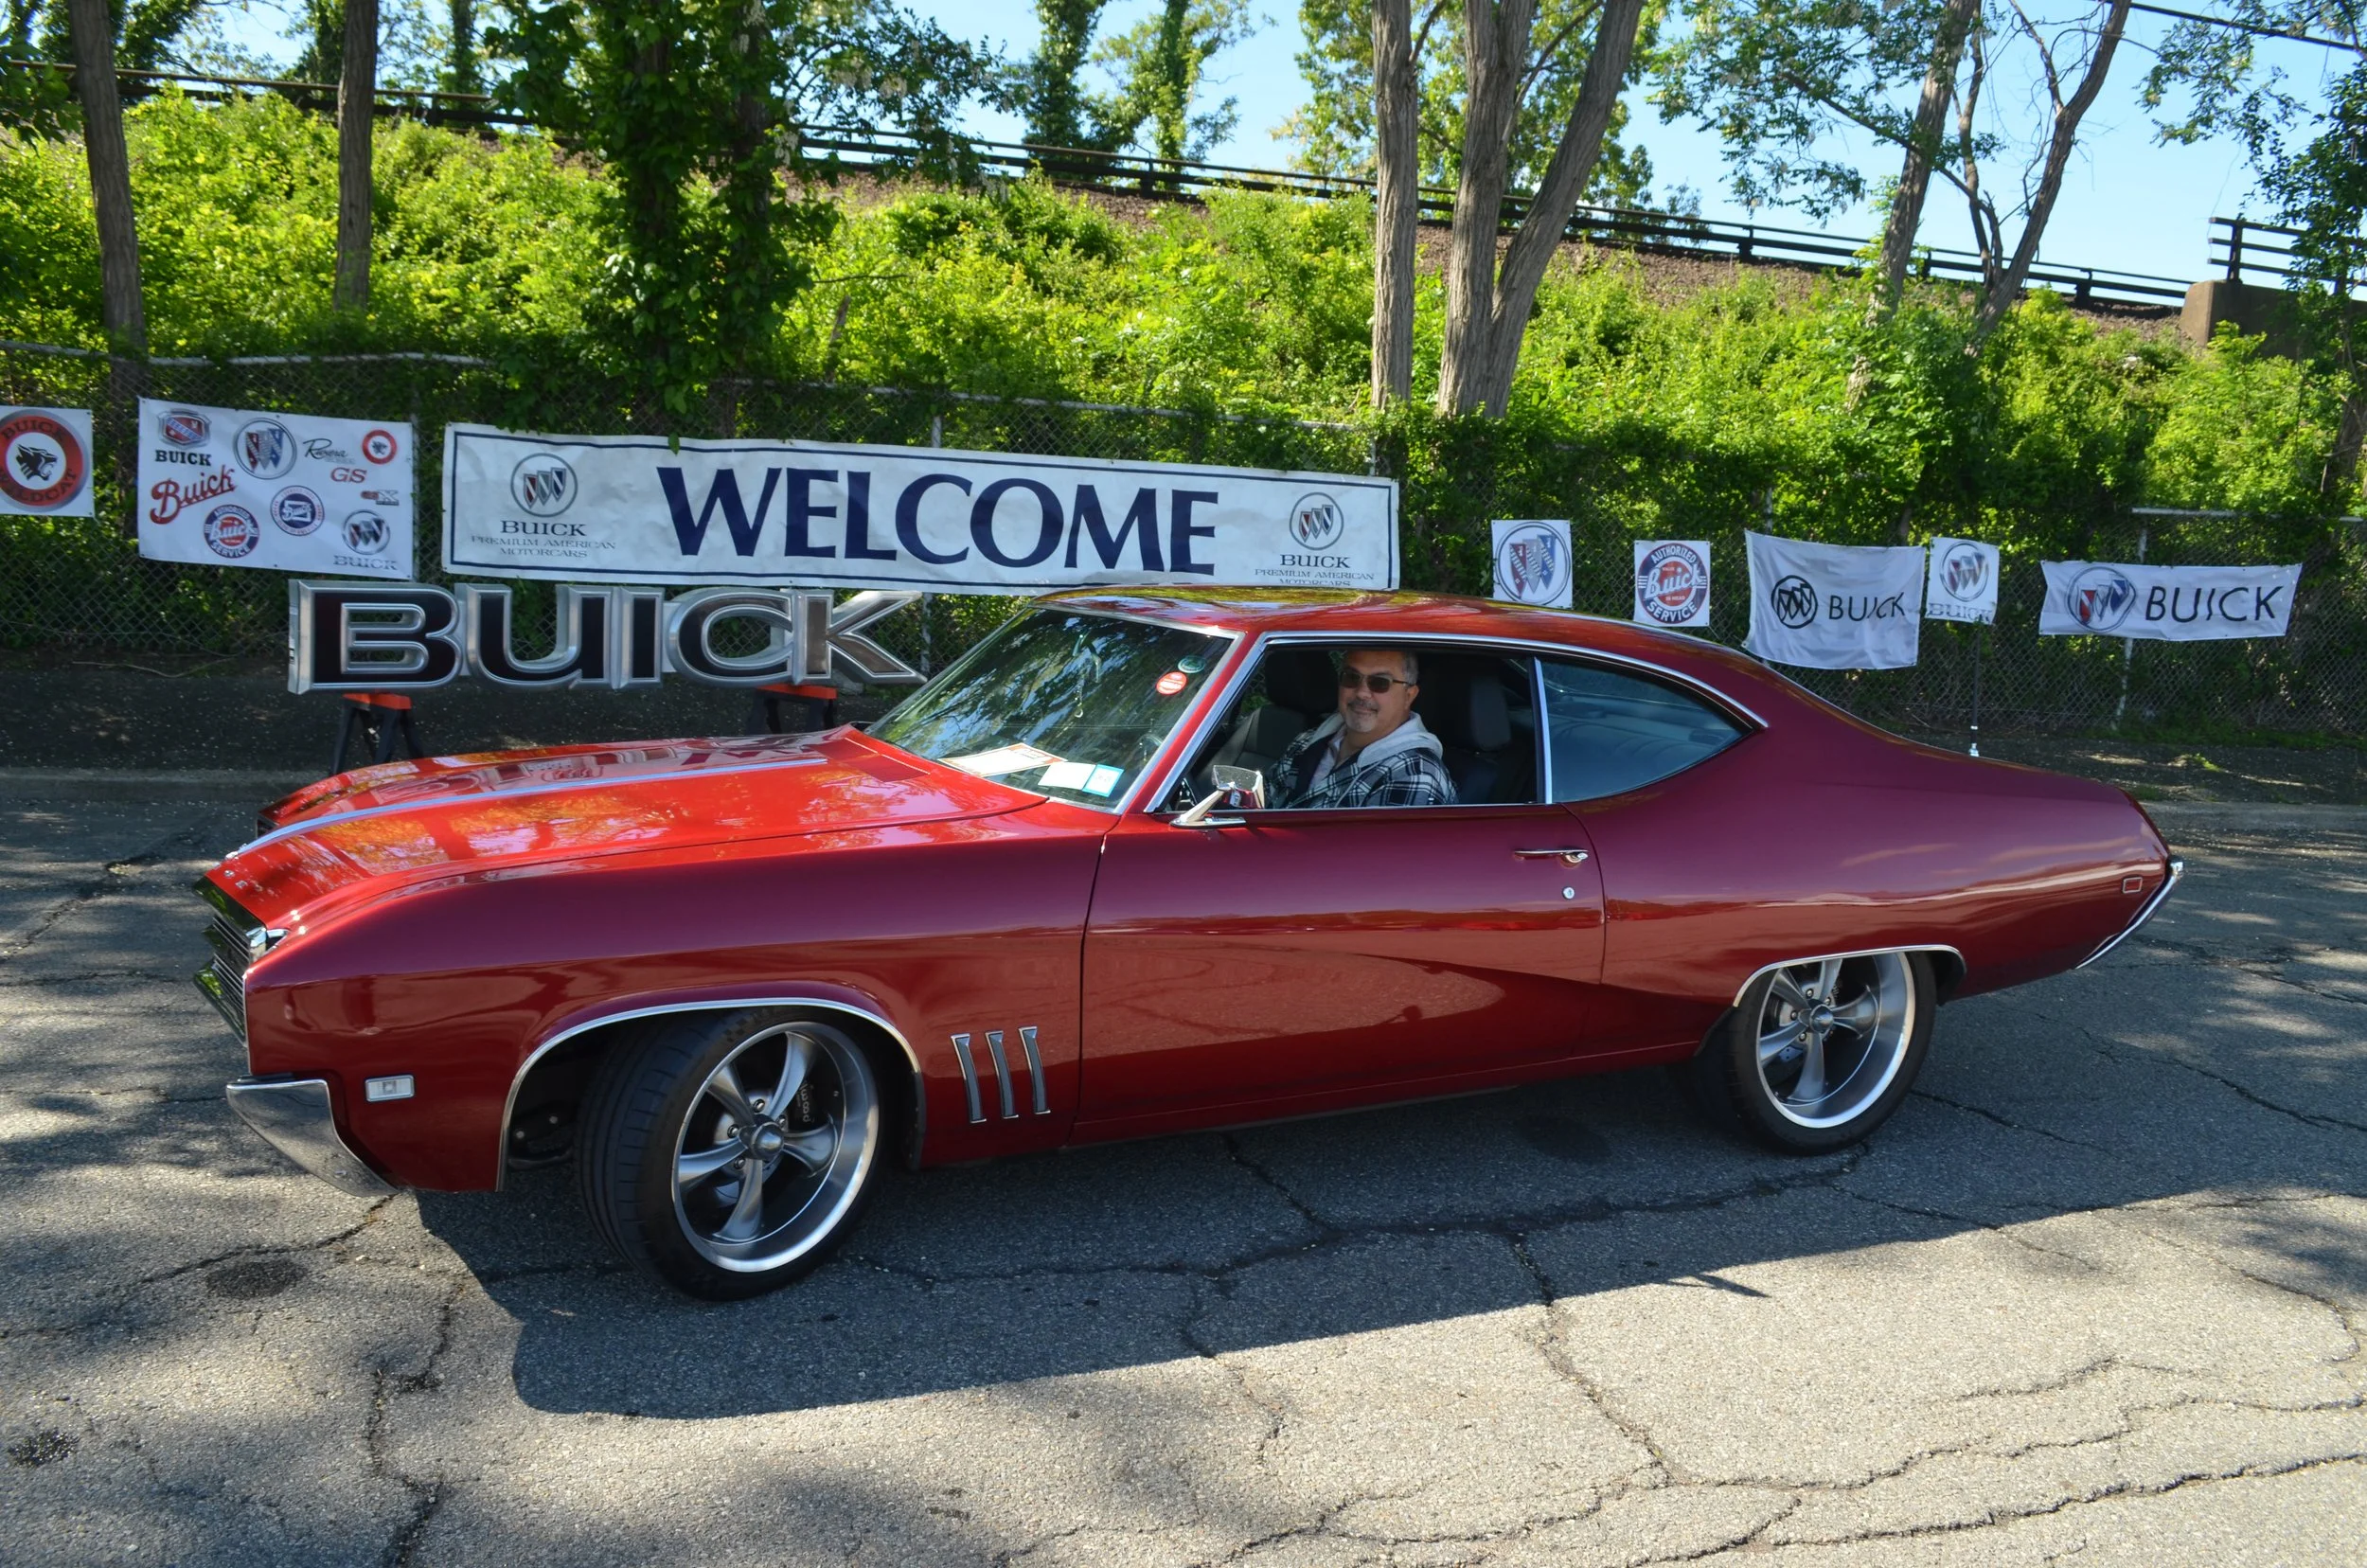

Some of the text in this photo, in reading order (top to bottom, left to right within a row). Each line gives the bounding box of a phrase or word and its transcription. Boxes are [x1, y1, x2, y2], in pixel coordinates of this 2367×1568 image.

[2, 419, 64, 442] BUICK
[155, 450, 211, 466] BUICK
[330, 467, 367, 483] GS
[150, 464, 236, 525] Buick
[209, 519, 258, 541] Buick
[500, 521, 587, 537] BUICK
[657, 466, 1219, 577] WELCOME
[472, 535, 615, 550] PREMIUM AMERICAN
[333, 555, 399, 570] BUICK
[500, 547, 587, 559] MOTORCARS
[1280, 554, 1351, 568] BUICK
[1650, 544, 1697, 564] AUTHORIZED
[1255, 568, 1374, 580] PREMIUM AMERICAN
[1644, 563, 1703, 599] Buick
[1647, 601, 1698, 622] SERVICE
[1829, 592, 1905, 621] BUICK
[2145, 585, 2284, 623] BUICK
[288, 579, 928, 694] BUICK
